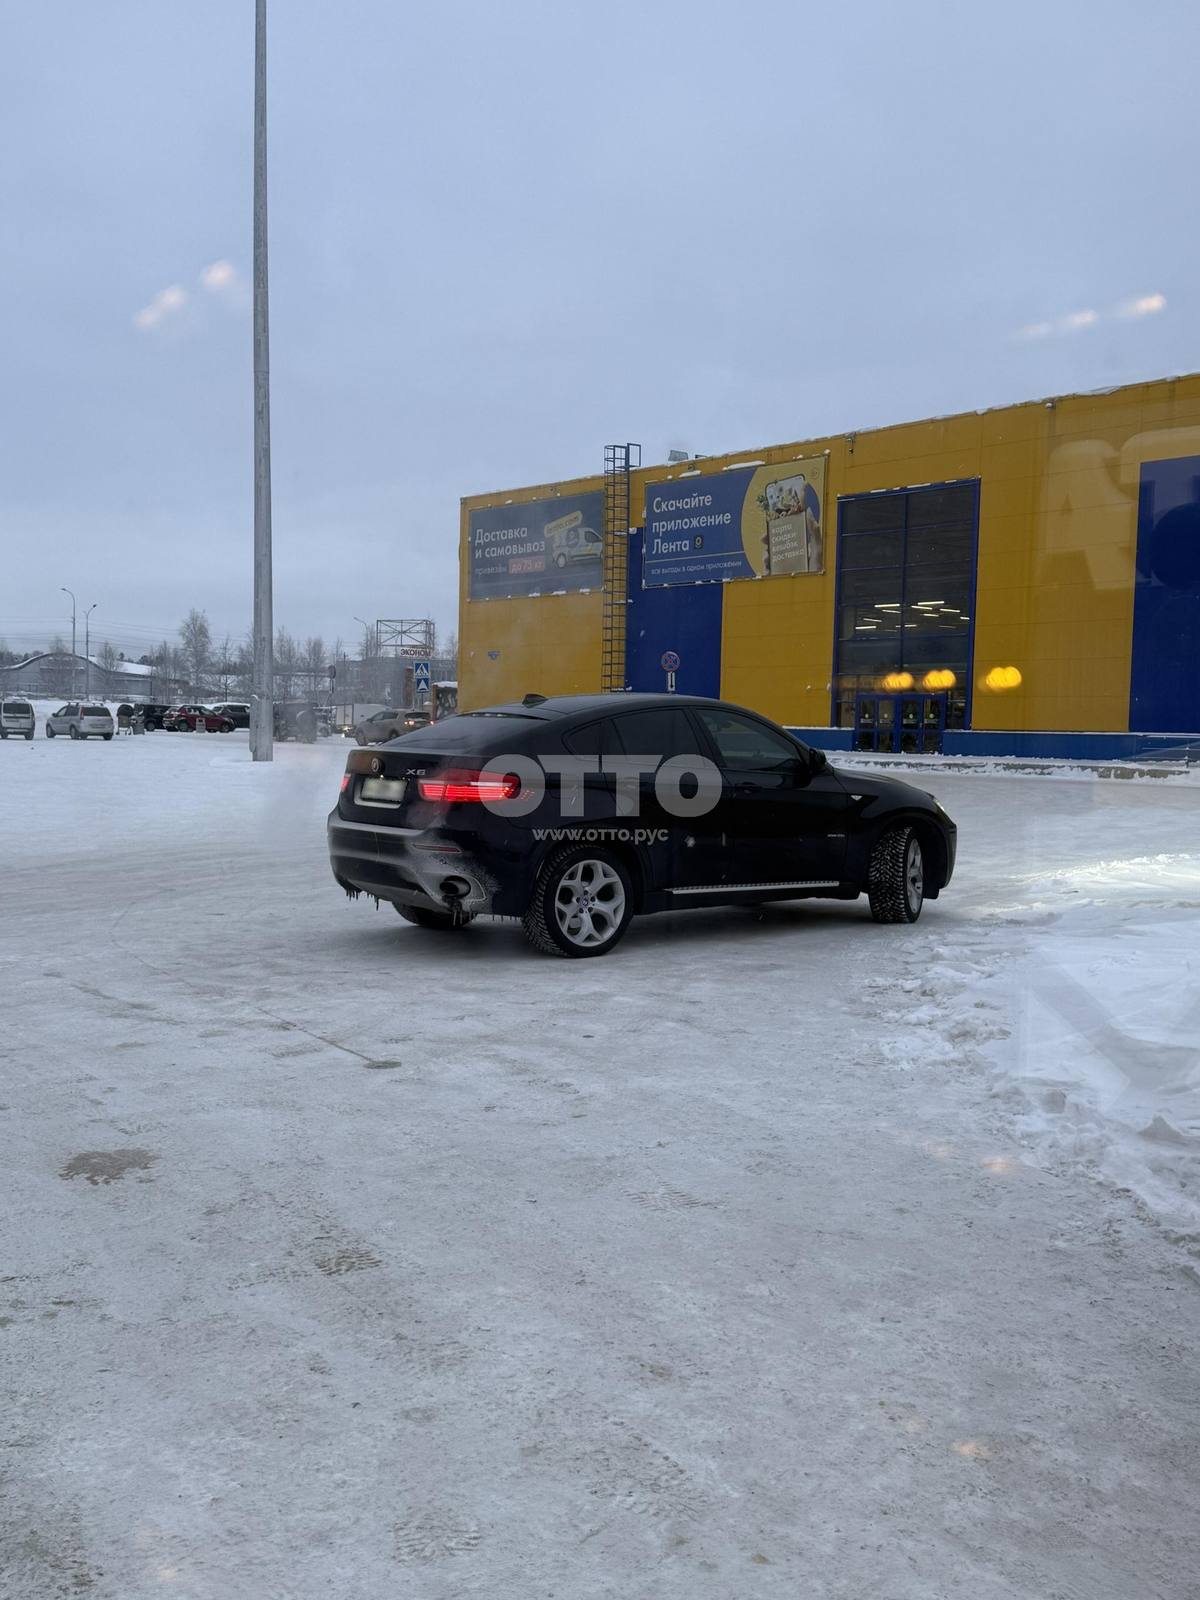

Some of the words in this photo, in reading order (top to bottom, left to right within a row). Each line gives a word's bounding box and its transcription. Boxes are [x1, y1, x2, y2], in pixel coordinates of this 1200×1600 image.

[652, 493, 712, 513] Скачайте
[651, 512, 732, 537] приложение
[474, 527, 528, 547] Доставка
[475, 548, 482, 560] и
[484, 540, 545, 558] самовывоз
[651, 538, 690, 555] Лента
[772, 548, 804, 562] доставка
[686, 564, 705, 573] одном
[400, 648, 432, 657] ЭКОНОМ
[405, 768, 426, 776] X6
